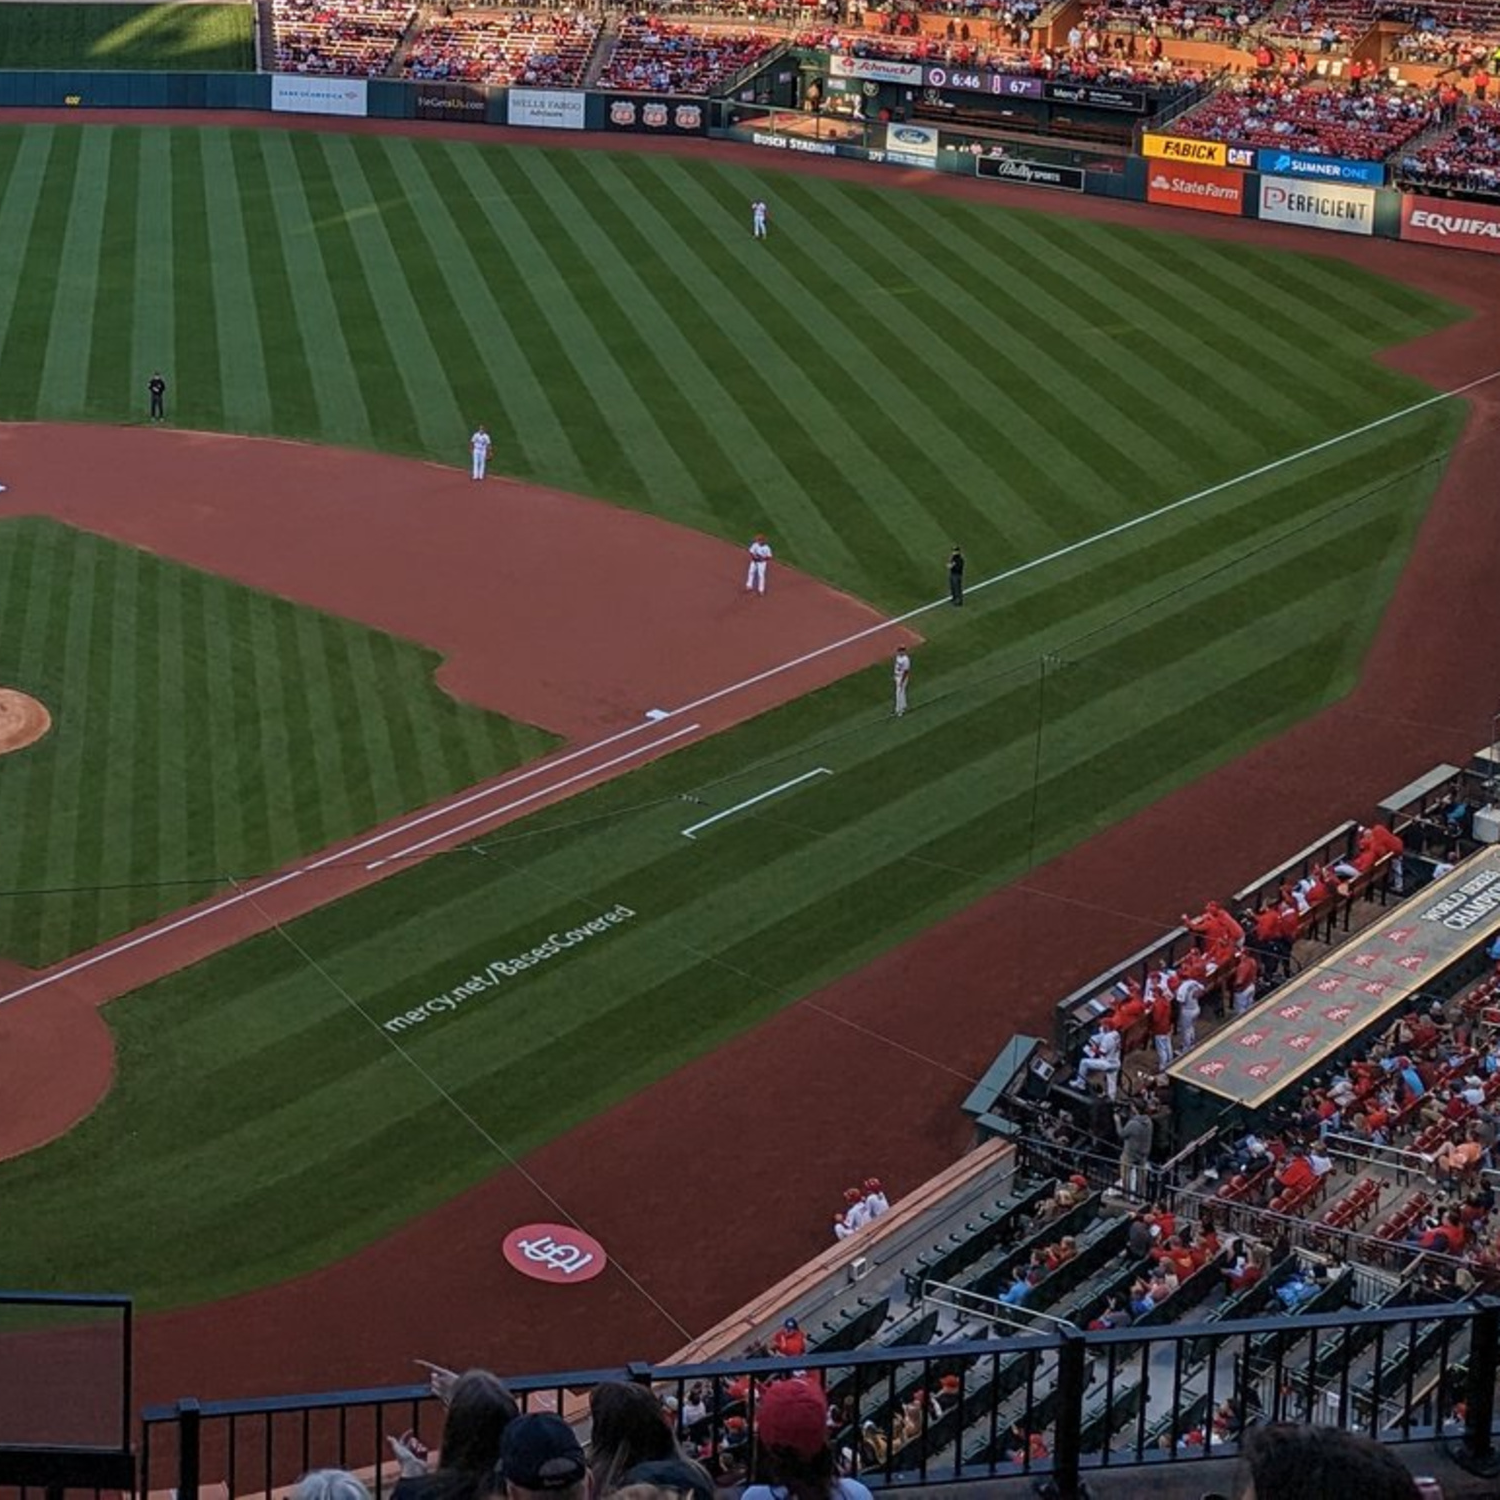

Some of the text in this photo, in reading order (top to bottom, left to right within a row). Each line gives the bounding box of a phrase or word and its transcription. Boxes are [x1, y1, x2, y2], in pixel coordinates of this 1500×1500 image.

[858, 60, 916, 76] Schnucks
[952, 73, 980, 89] 6:46
[1009, 80, 1032, 94] 67°
[753, 132, 837, 155] BUSCH STADIUM
[899, 130, 926, 145] Ford
[1162, 140, 1254, 166] FABICK CAT
[1034, 170, 1061, 182] SPORTS
[1291, 159, 1369, 180] SUMNER ONE
[1264, 186, 1368, 221] PERFICIENT
[1410, 210, 1500, 238] EQUIFA
[1420, 892, 1468, 921] WORLD
[383, 903, 637, 1033] mercy.net/BasesCovered
